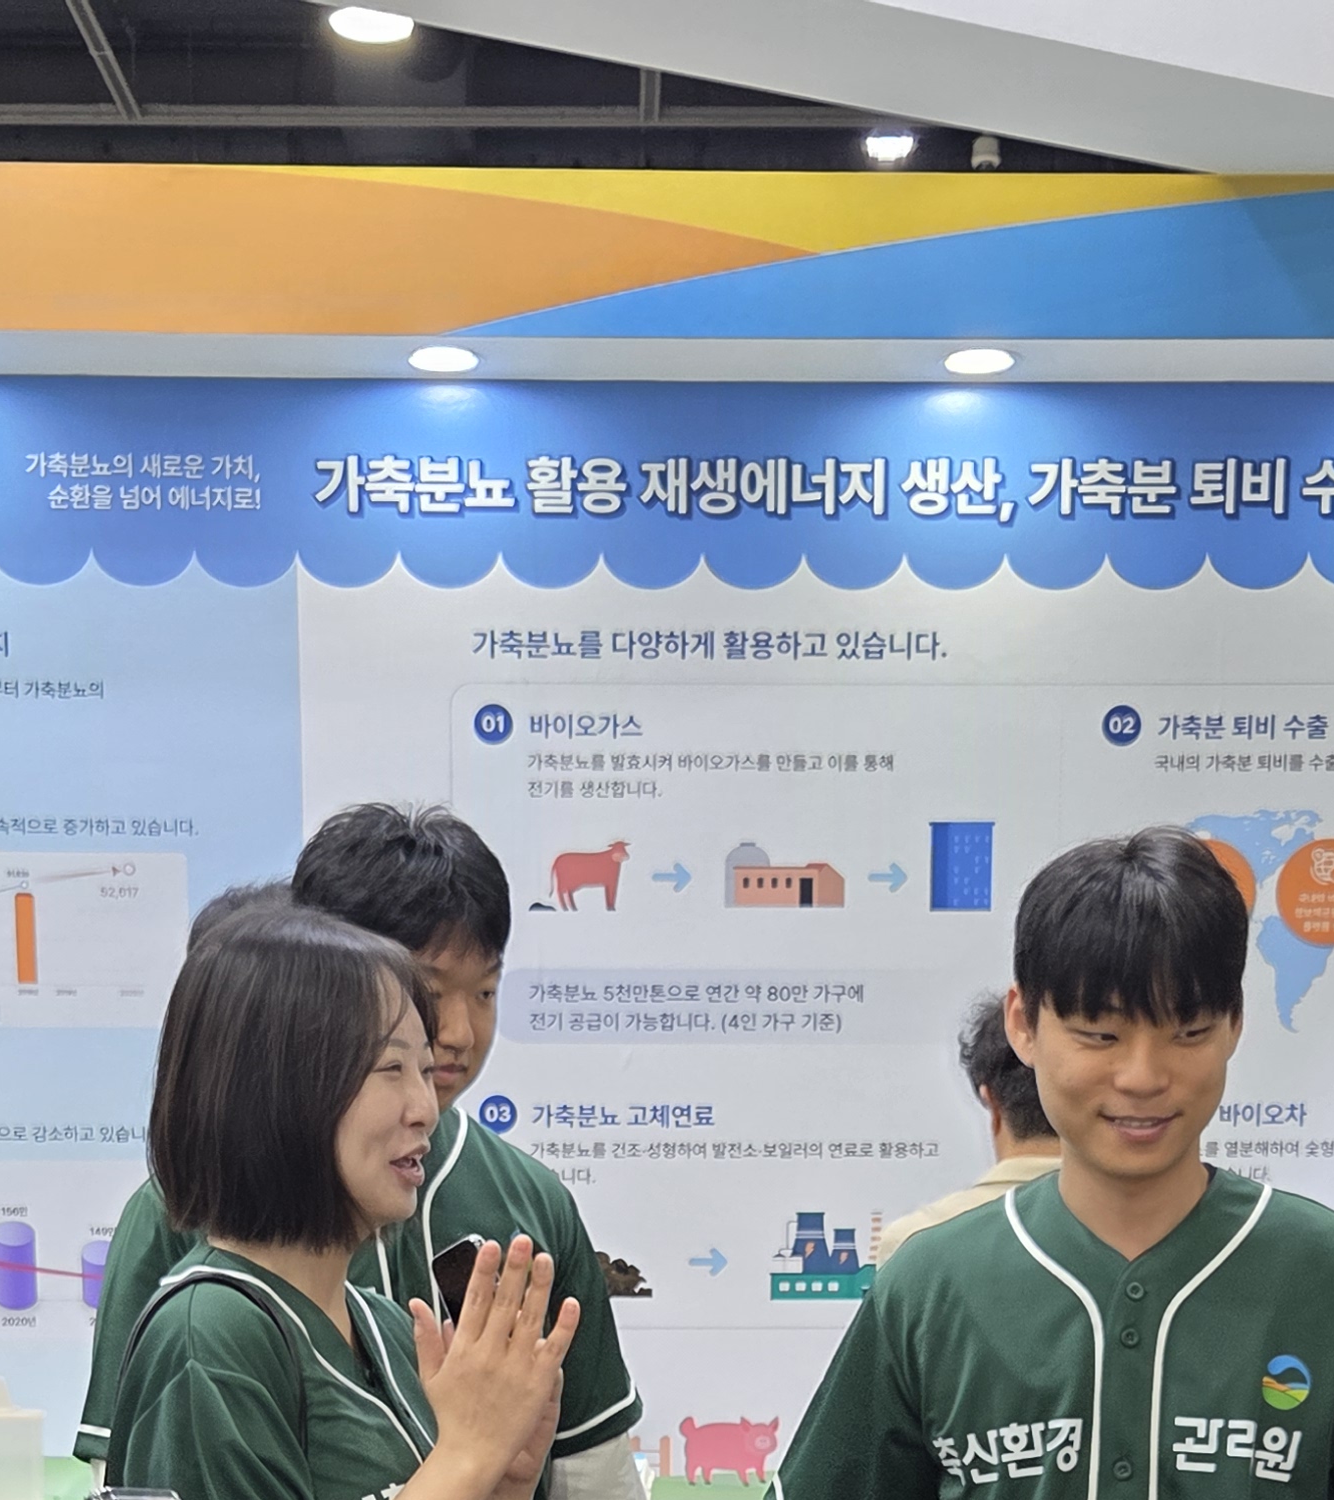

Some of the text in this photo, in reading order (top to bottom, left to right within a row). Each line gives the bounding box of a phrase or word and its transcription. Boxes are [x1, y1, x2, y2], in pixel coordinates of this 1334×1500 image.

[25, 451, 260, 482] 가축분뇨의 새로운 가치,
[47, 483, 261, 511] 순환을 넘어 에너지로!
[315, 456, 515, 514] 가축분뇨
[528, 456, 625, 514] 활용
[641, 457, 886, 516] 재생에너지
[901, 457, 1014, 522] 생산,
[1029, 458, 1177, 515] 가축분
[1190, 458, 1286, 514] 퇴비
[473, 629, 947, 661] 가축분뇨를 다양하게 활용하고 있습니다.
[24, 680, 104, 699] 가축분뇨의
[481, 713, 505, 733] 01
[529, 713, 643, 740] 바이오가스
[1109, 716, 1135, 735] 02
[1158, 714, 1328, 740] 가축분 퇴비 수출
[528, 753, 894, 772] 가축분뇨를 발효시켜 바이오가스를 만들고 이를 통해
[1154, 754, 1200, 772] 국내의
[1206, 754, 1252, 772] 가축분
[1257, 753, 1304, 772] 퇴비를
[527, 780, 662, 799] 전기를 생산합니다.
[63, 818, 126, 836] 증가하고
[131, 818, 199, 837] 있습니다.
[529, 984, 864, 1003] 가축분뇨 5천만톤으로 연간 약 80만 가구에
[529, 1012, 842, 1034] 전기 공급이 가능합니다. (4인 가구 기준)
[486, 1105, 510, 1123] 03
[532, 1104, 715, 1128] 가축분뇨 고체연료
[1220, 1103, 1307, 1127] 바이오차
[33, 1125, 94, 1143] 감소하고
[531, 1142, 606, 1159] 가축분뇨를
[829, 1142, 873, 1160] 연료로
[878, 1141, 939, 1160] 활용하고
[1225, 1141, 1299, 1158] 열분해하여
[932, 1417, 1083, 1487] 축산환경
